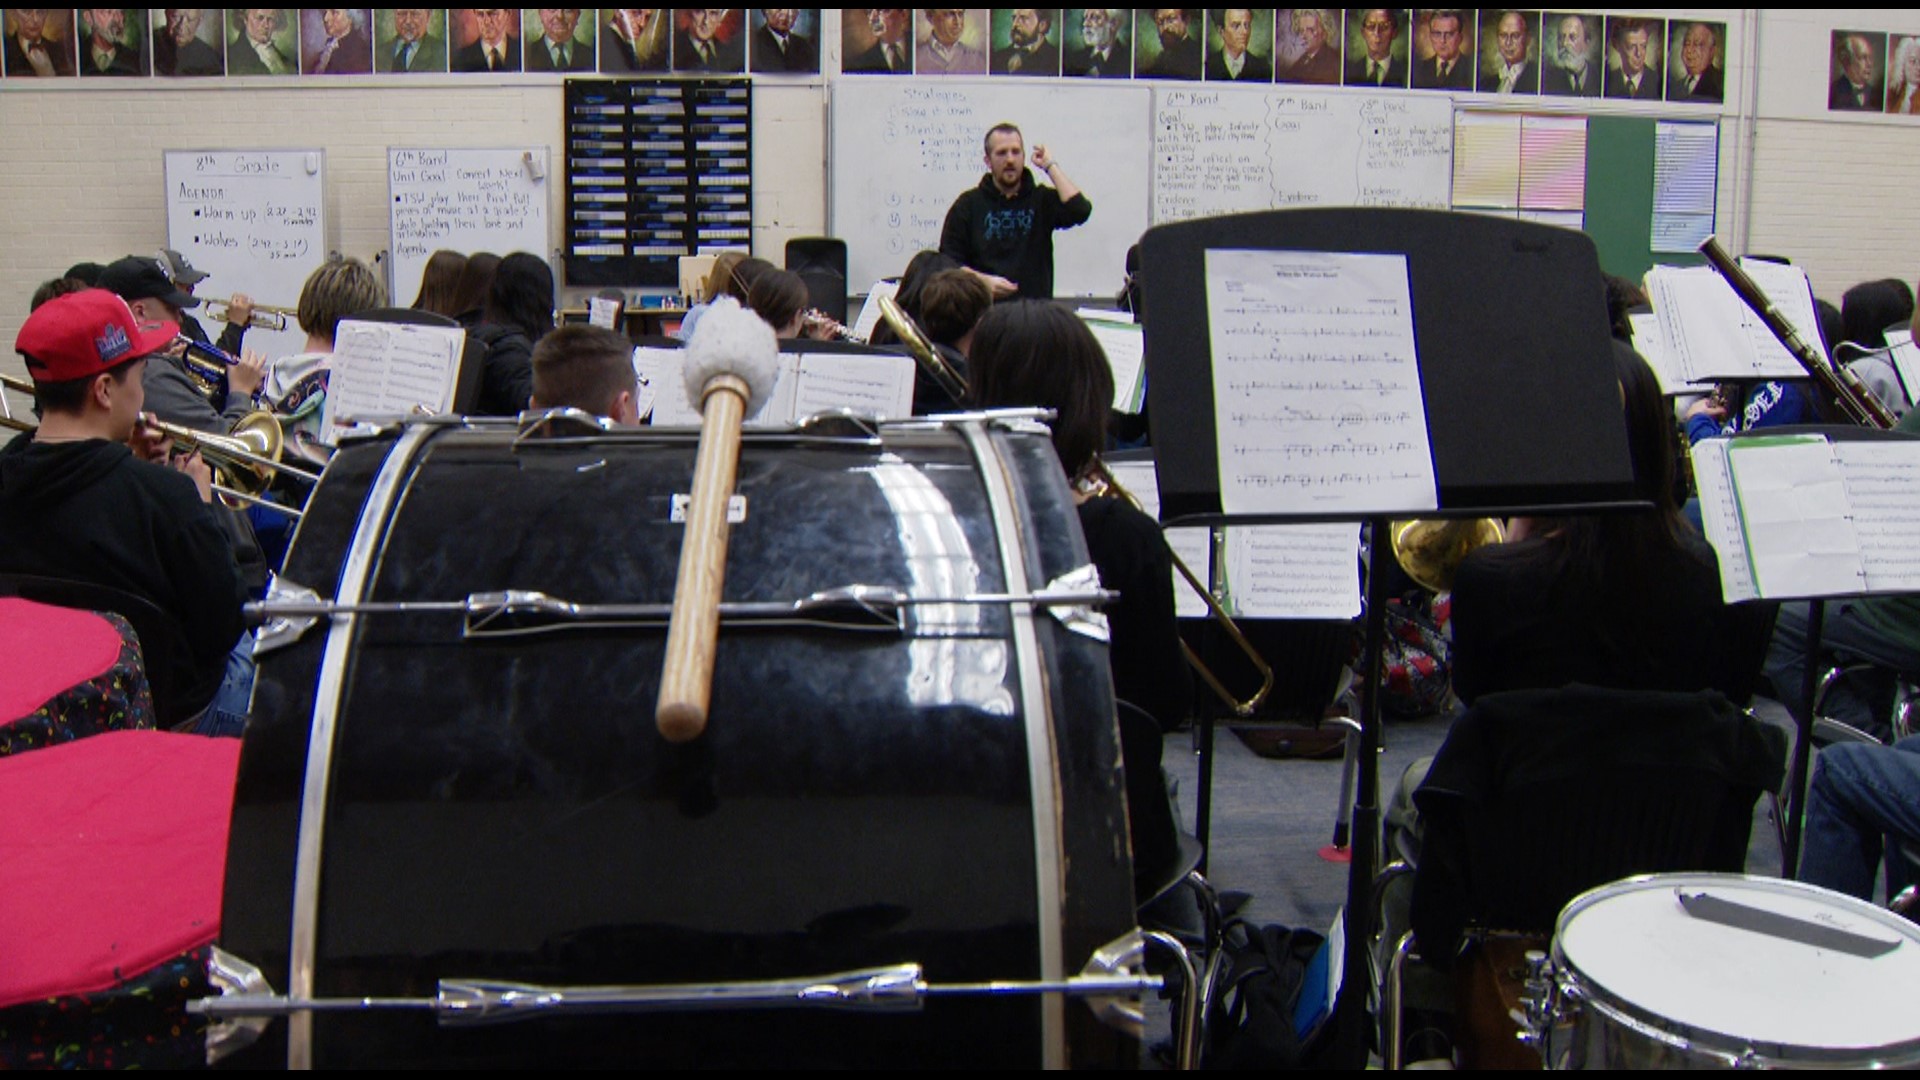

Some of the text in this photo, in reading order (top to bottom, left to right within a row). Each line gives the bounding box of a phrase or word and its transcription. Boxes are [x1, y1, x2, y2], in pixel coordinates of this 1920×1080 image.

[1166, 92, 1218, 106] 6th Band
[1276, 98, 1328, 110] 7th Band
[196, 155, 280, 173] 8th Grade
[396, 150, 448, 167] 6th Band
[393, 170, 416, 182] Unit
[456, 168, 490, 180] Concert
[499, 169, 524, 180] Next
[430, 192, 449, 208] play
[204, 205, 234, 220] Warm
[241, 211, 256, 225] up
[437, 206, 462, 214] music
[204, 231, 238, 248] Wolves
